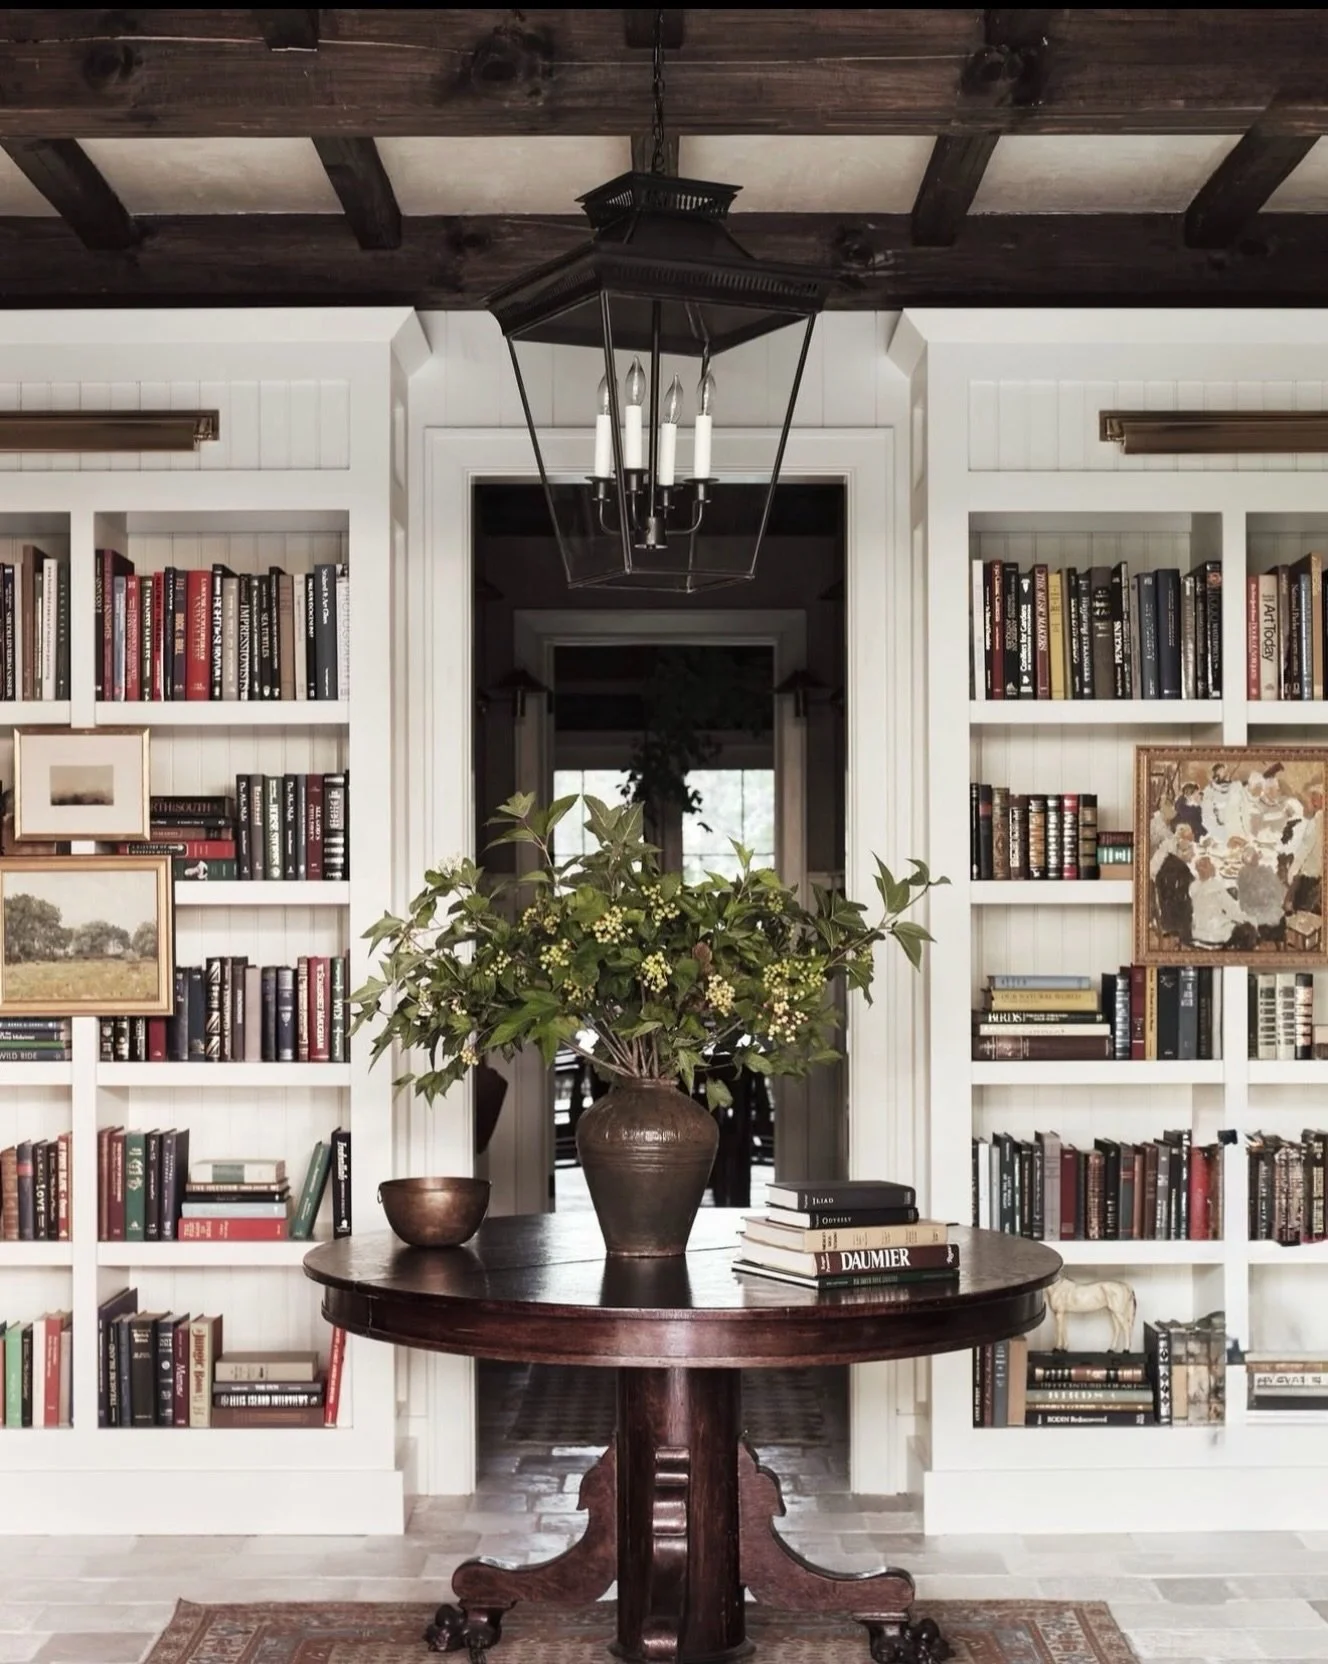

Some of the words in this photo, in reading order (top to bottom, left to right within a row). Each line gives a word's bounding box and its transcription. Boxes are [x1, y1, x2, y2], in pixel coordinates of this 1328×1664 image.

[1290, 584, 1298, 611] National
[175, 613, 184, 631] ROCK
[261, 613, 269, 626] SEA
[1020, 604, 1028, 632] Gardens
[1263, 604, 1276, 623] Art
[1291, 612, 1299, 630] Parks
[175, 639, 184, 655] ROLL
[261, 628, 269, 658] TURTLES
[1020, 633, 1028, 643] for
[1114, 621, 1123, 664] PENGUINS
[1262, 624, 1276, 662] Today
[239, 605, 250, 691] IMPRESSIONISTS
[1020, 644, 1028, 672] Conifers
[175, 802, 211, 812] SOUTH
[333, 998, 343, 1020] KIM
[988, 1013, 1023, 1022] BIRDS
[20, 1052, 38, 1060] RIDE
[36, 1185, 46, 1212] LOVE
[812, 1196, 834, 1205] ILIAD
[821, 1216, 852, 1225] ODYSSEY
[840, 1248, 911, 1271] DAUMIER
[247, 1395, 270, 1406] ISLAND
[271, 1394, 308, 1406] INTERVIEWS
